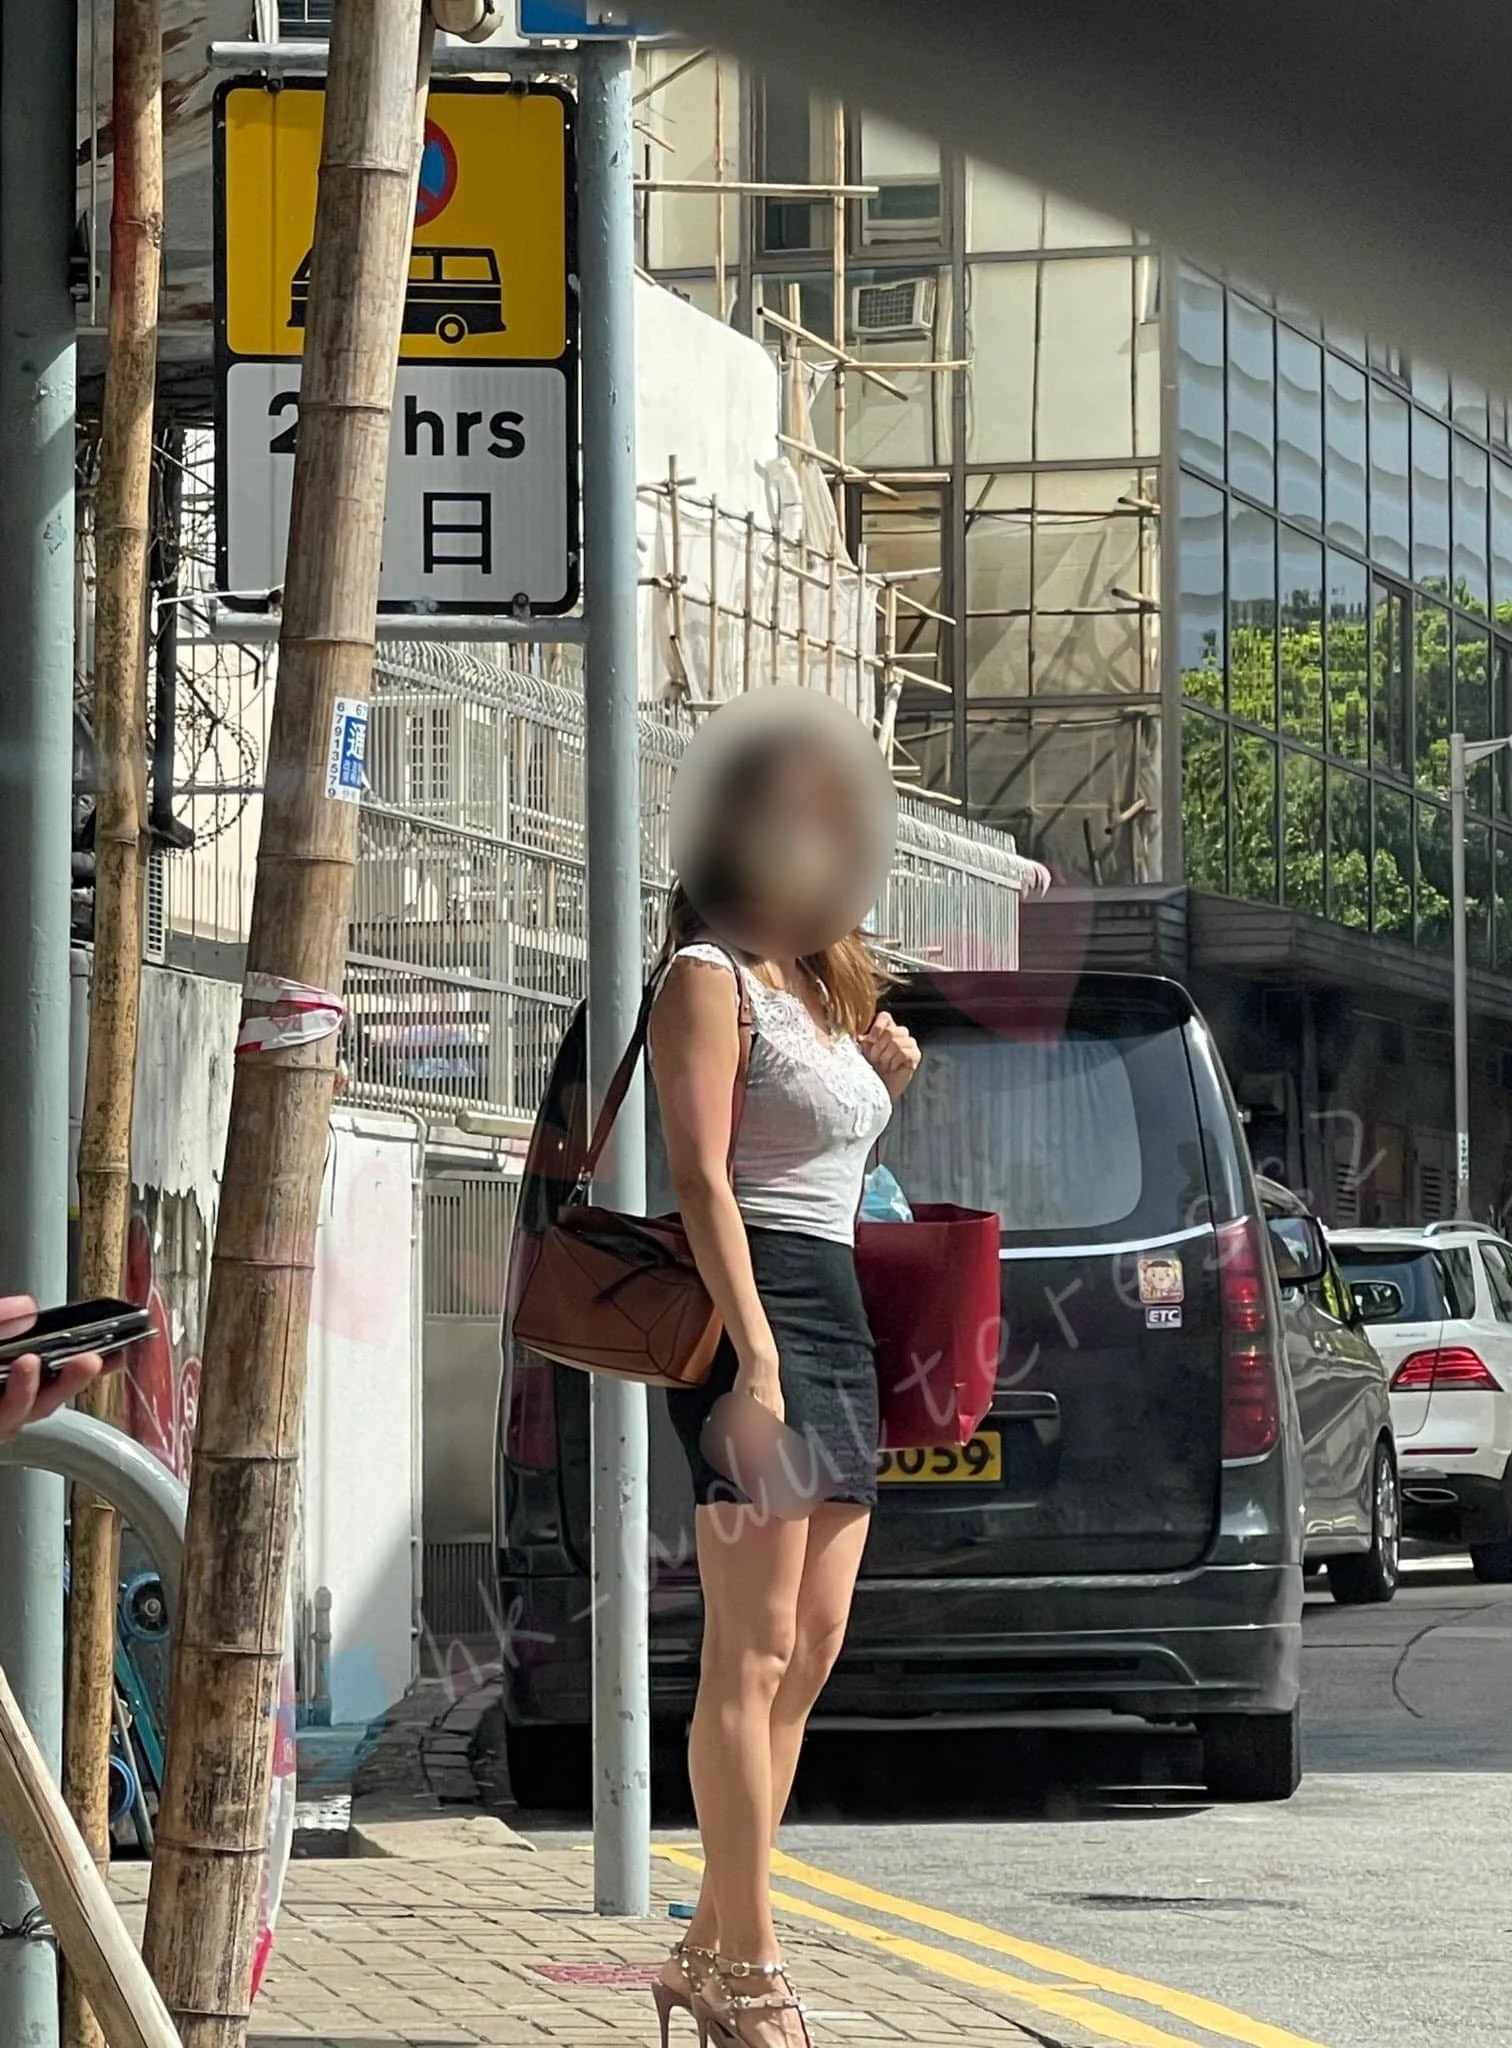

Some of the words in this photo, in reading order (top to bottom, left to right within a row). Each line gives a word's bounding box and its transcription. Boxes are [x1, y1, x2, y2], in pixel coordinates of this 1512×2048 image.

[404, 395, 526, 459] hrs
[380, 491, 492, 575] 日
[1148, 1309, 1179, 1323] ETC
